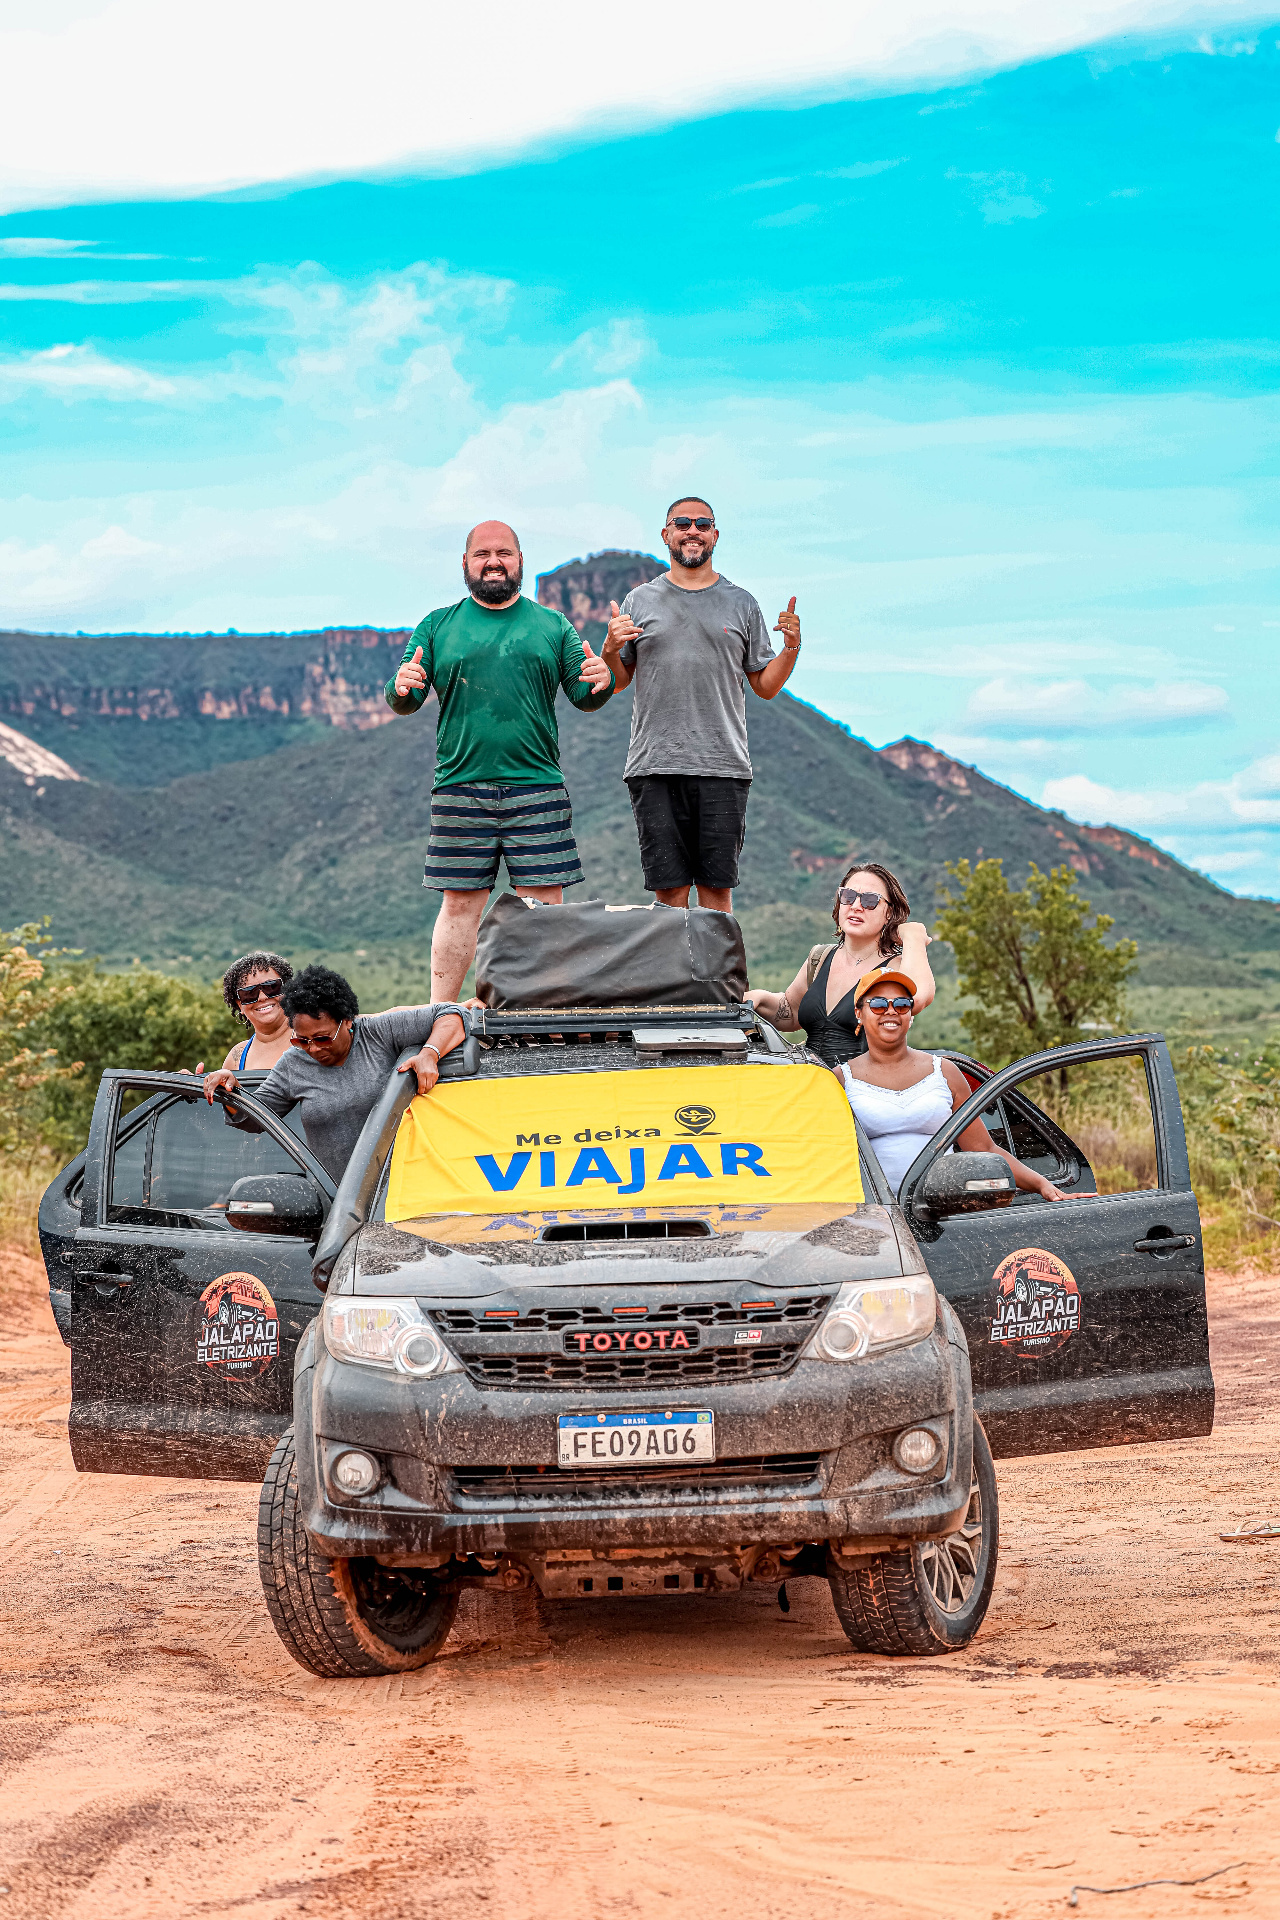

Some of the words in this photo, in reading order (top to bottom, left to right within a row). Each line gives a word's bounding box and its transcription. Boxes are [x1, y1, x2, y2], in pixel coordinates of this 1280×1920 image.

[516, 1132, 562, 1147] Me
[473, 1143, 773, 1194] VIAJAR
[990, 1316, 1079, 1341] ELETRIZANTE
[573, 1330, 690, 1352] TOYOTA
[1023, 1337, 1051, 1346] TURISMO
[197, 1342, 277, 1361] ELETRIZANTE
[561, 1453, 570, 1462] BR
